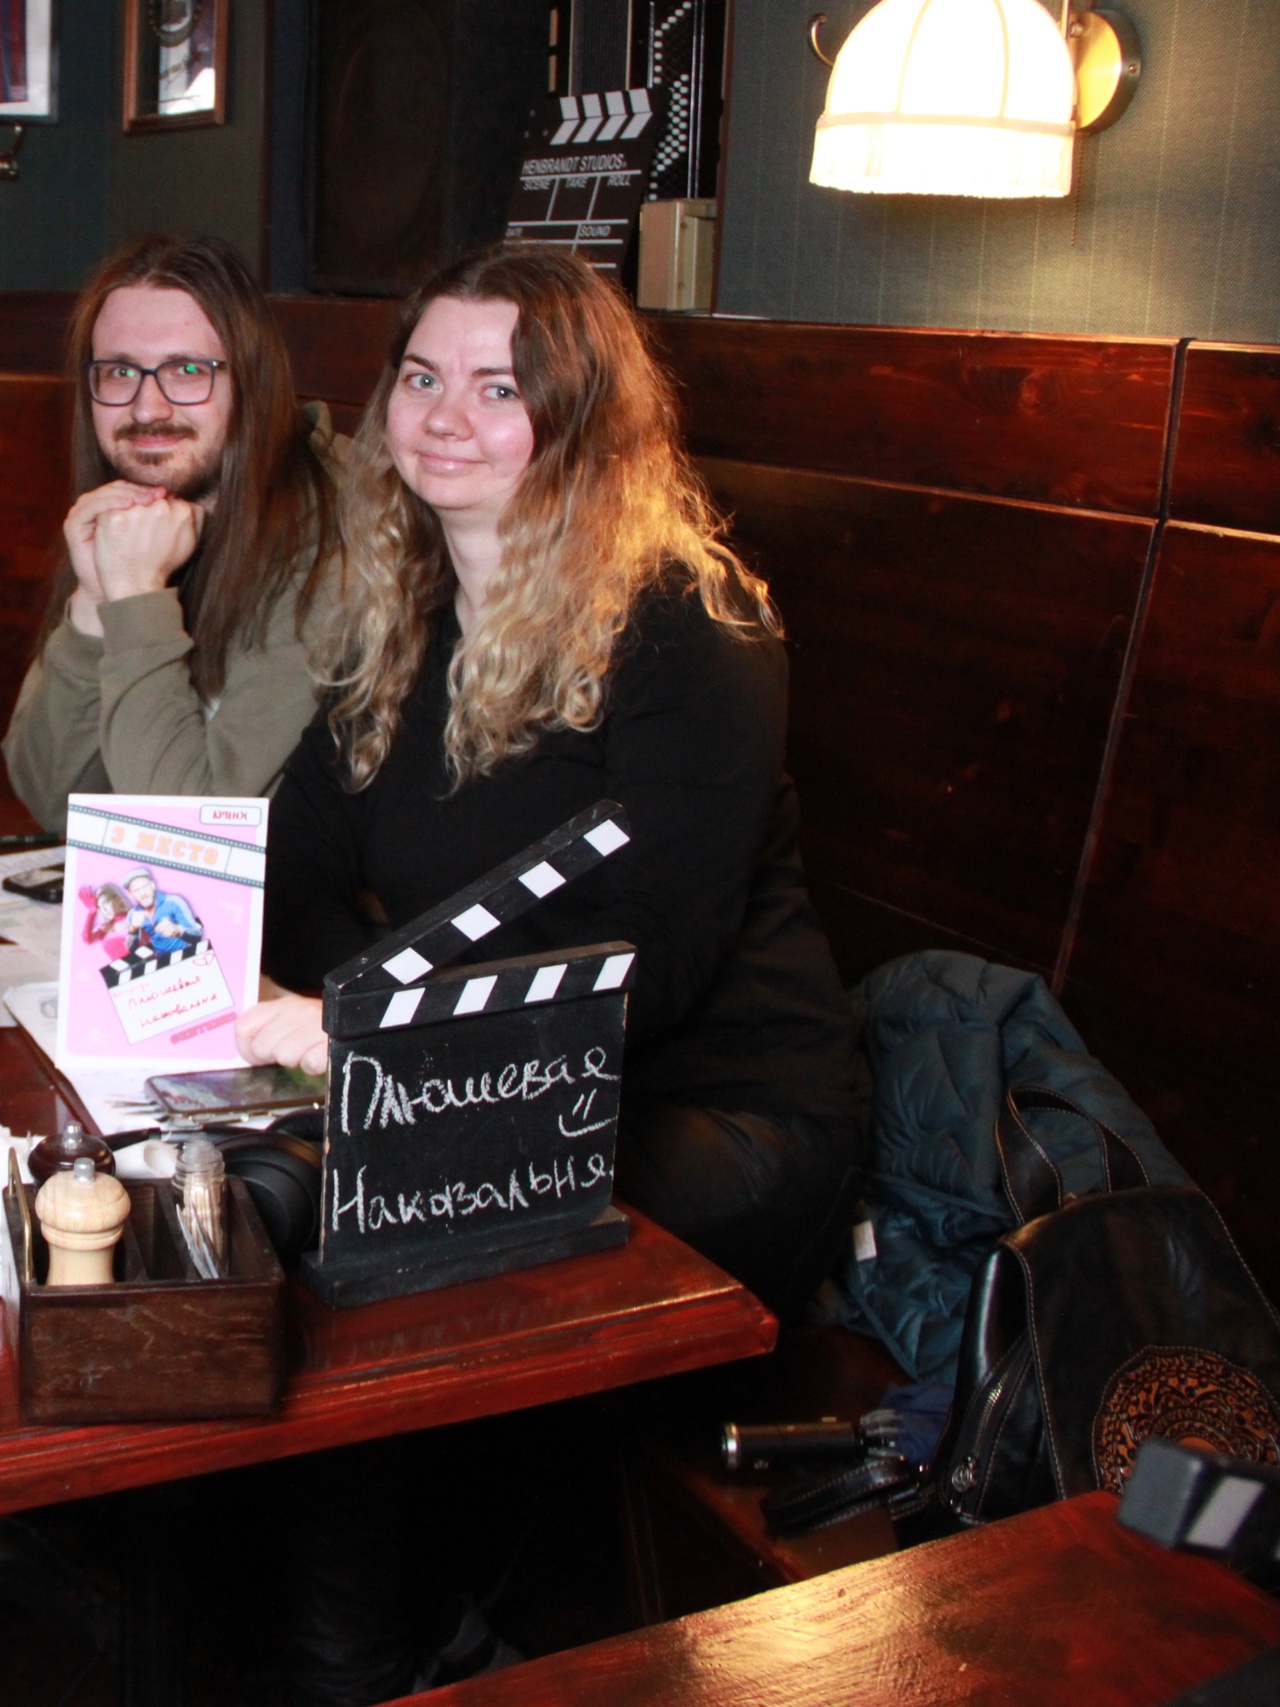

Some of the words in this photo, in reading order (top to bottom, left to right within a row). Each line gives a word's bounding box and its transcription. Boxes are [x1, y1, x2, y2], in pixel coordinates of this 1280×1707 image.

[565, 176, 589, 188] TAKE
[607, 174, 631, 187] ROLL
[579, 225, 611, 238] SOUND
[110, 826, 126, 844] 3
[135, 832, 219, 866] МЕСТО
[341, 1046, 619, 1136] Плюшевая
